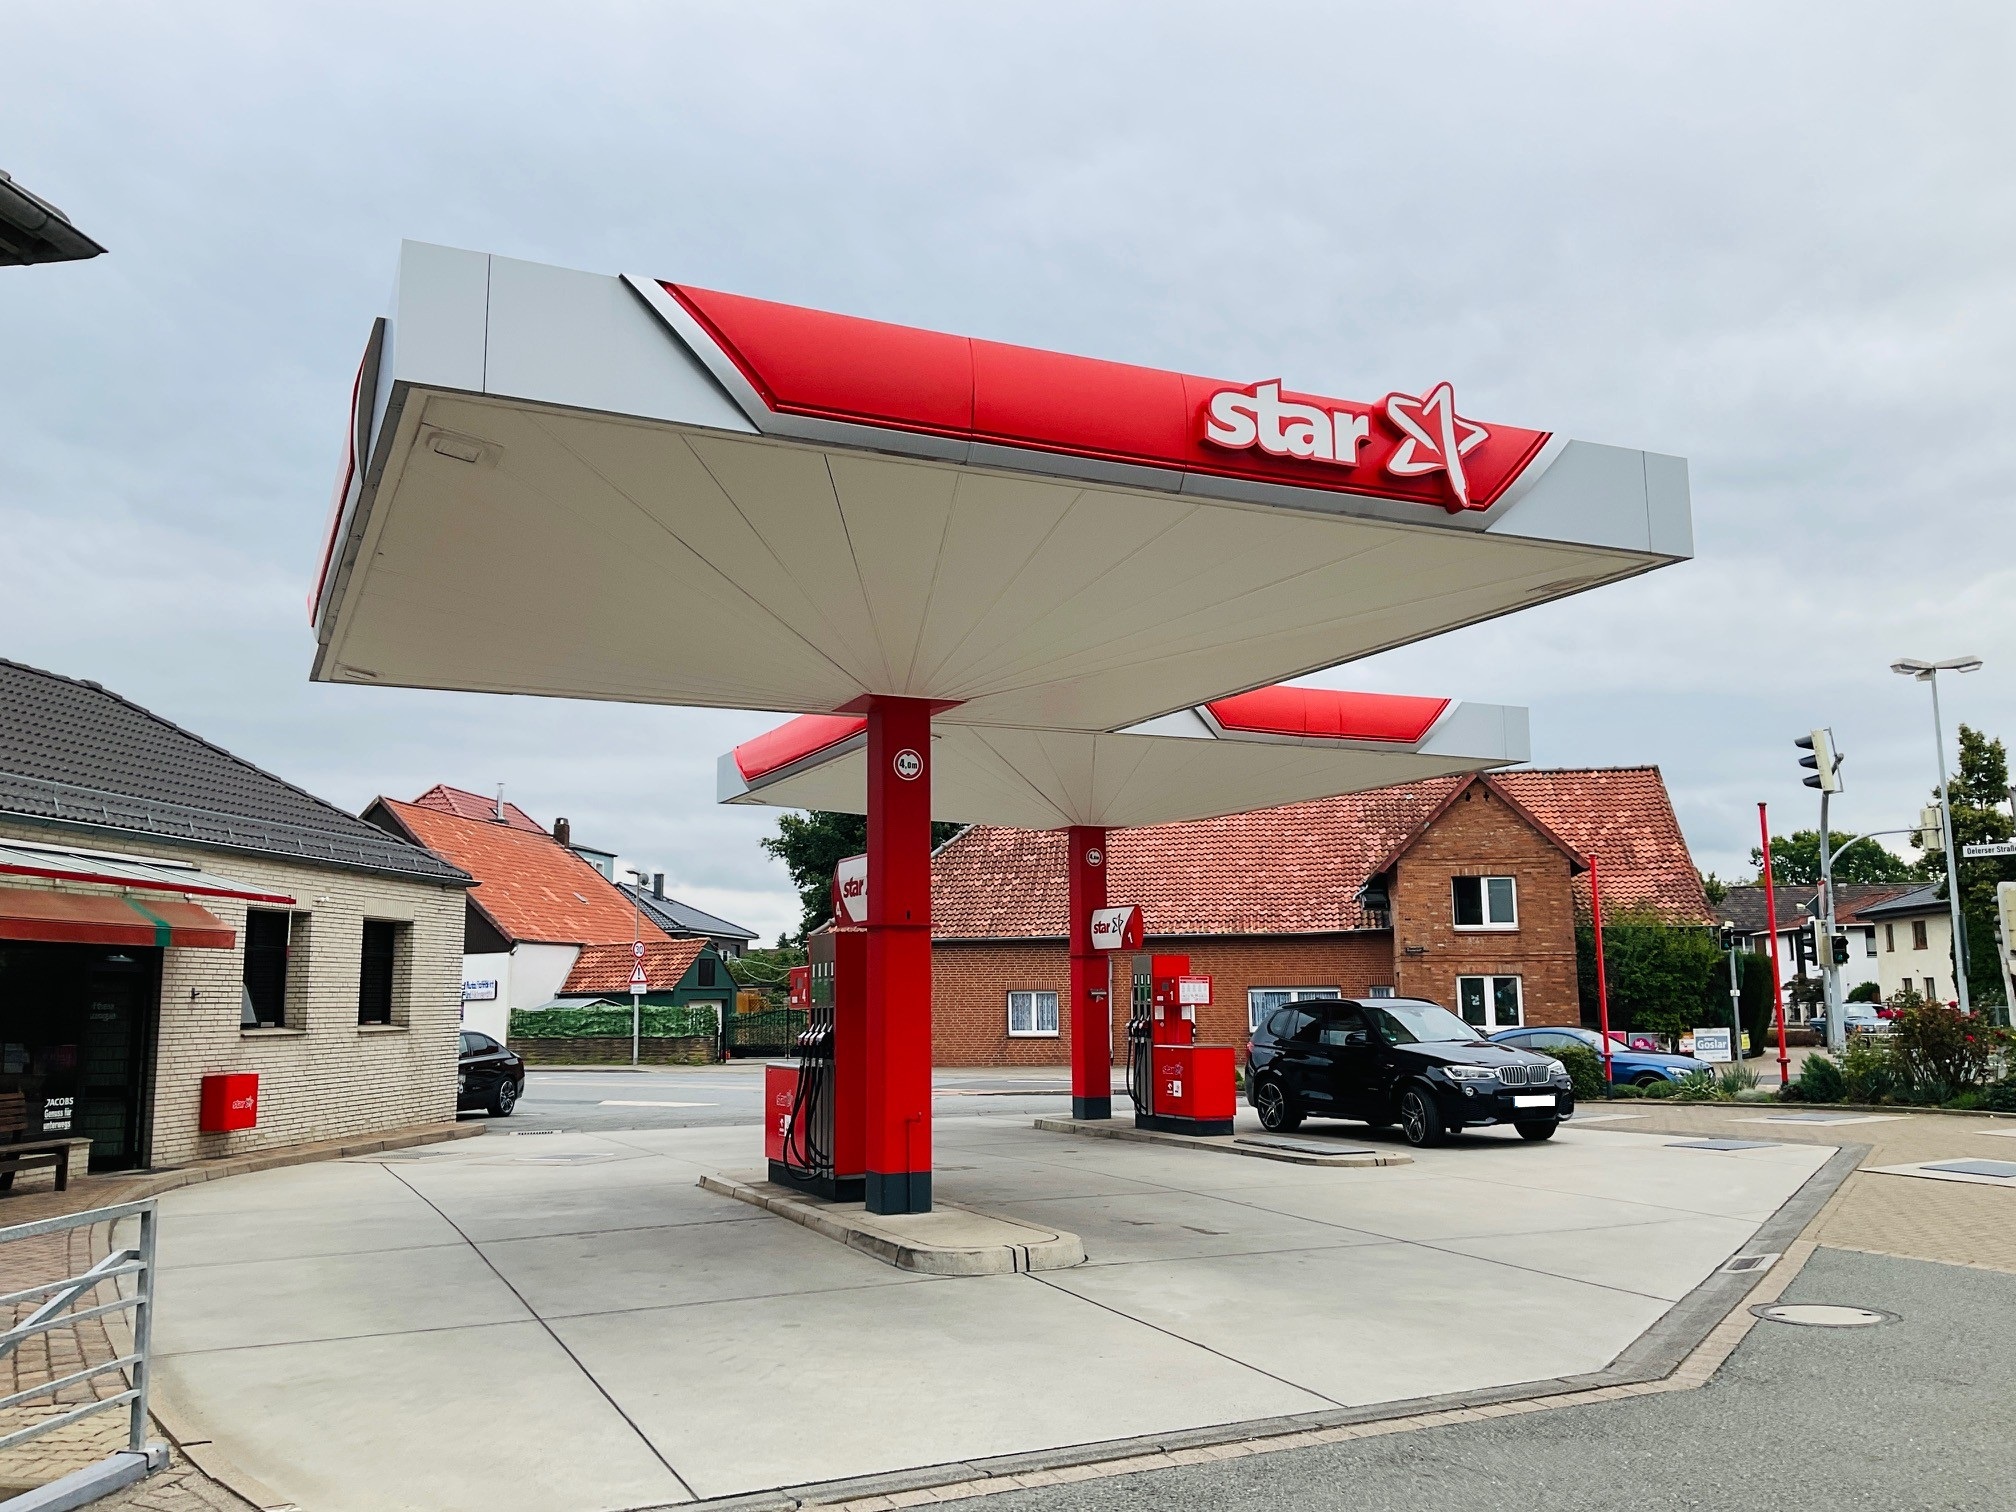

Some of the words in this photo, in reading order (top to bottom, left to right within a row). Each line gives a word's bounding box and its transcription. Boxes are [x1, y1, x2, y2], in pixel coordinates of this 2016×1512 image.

[1206, 381, 1370, 465] star
[843, 877, 864, 899] star
[835, 901, 842, 918] 4
[1093, 920, 1111, 935] star
[1127, 931, 1133, 944] 1
[635, 945, 644, 955] 30
[1697, 1039, 1727, 1050] Goslar
[44, 1097, 74, 1108] JACOBS
